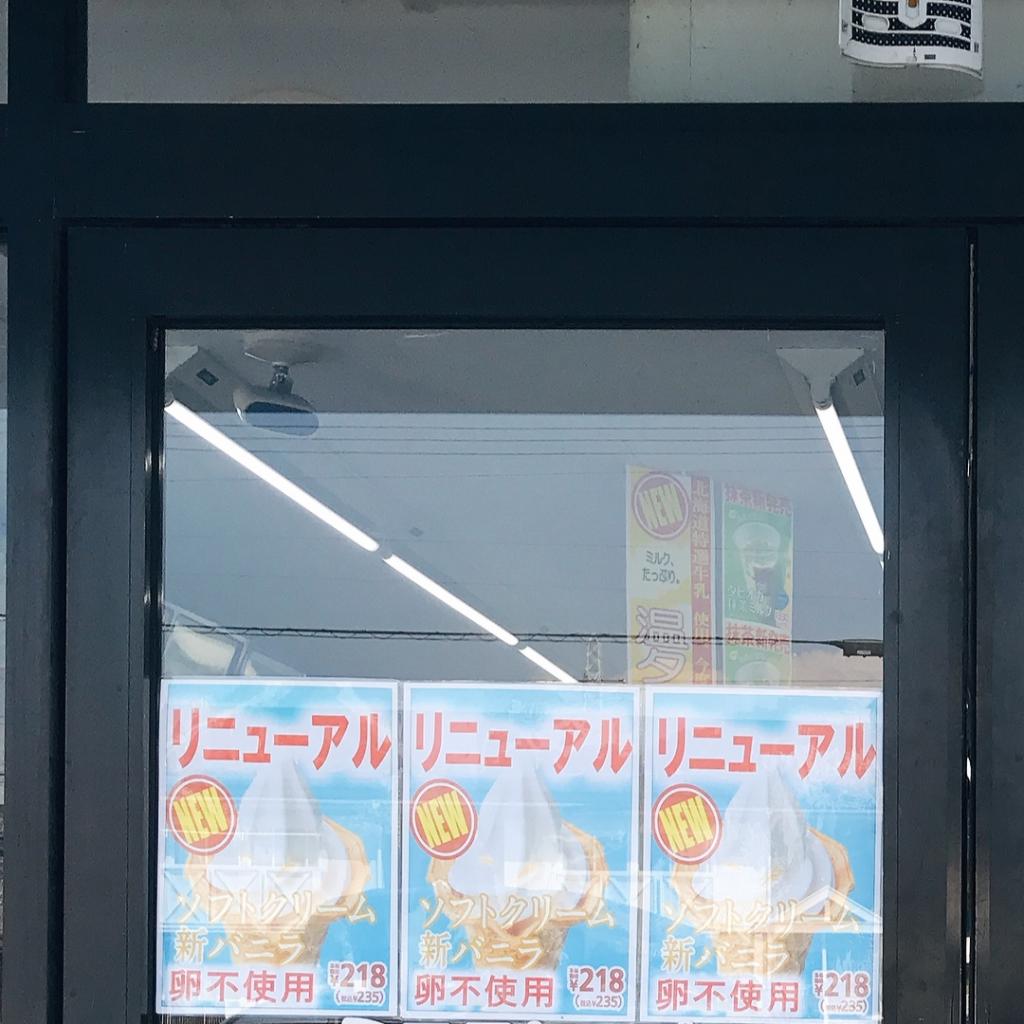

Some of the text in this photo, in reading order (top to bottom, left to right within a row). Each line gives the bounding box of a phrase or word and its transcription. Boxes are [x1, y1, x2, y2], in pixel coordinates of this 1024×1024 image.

[642, 567, 680, 584] たっぷり。
[172, 708, 392, 770] リニューアル
[415, 711, 632, 774] リニューアル
[658, 717, 877, 779] リニューアル
[173, 786, 228, 845] NEW
[416, 790, 468, 849] NEW
[659, 796, 714, 853] NEW
[177, 892, 376, 925] ソフトクリーム
[420, 895, 615, 929] ソフトクリーム
[175, 927, 306, 964] 新バニラ
[419, 931, 545, 969] 新バニラ
[169, 970, 314, 1003] 卵不使用
[414, 975, 553, 1008] 卵不使用
[656, 979, 799, 1012] 卵不使用
